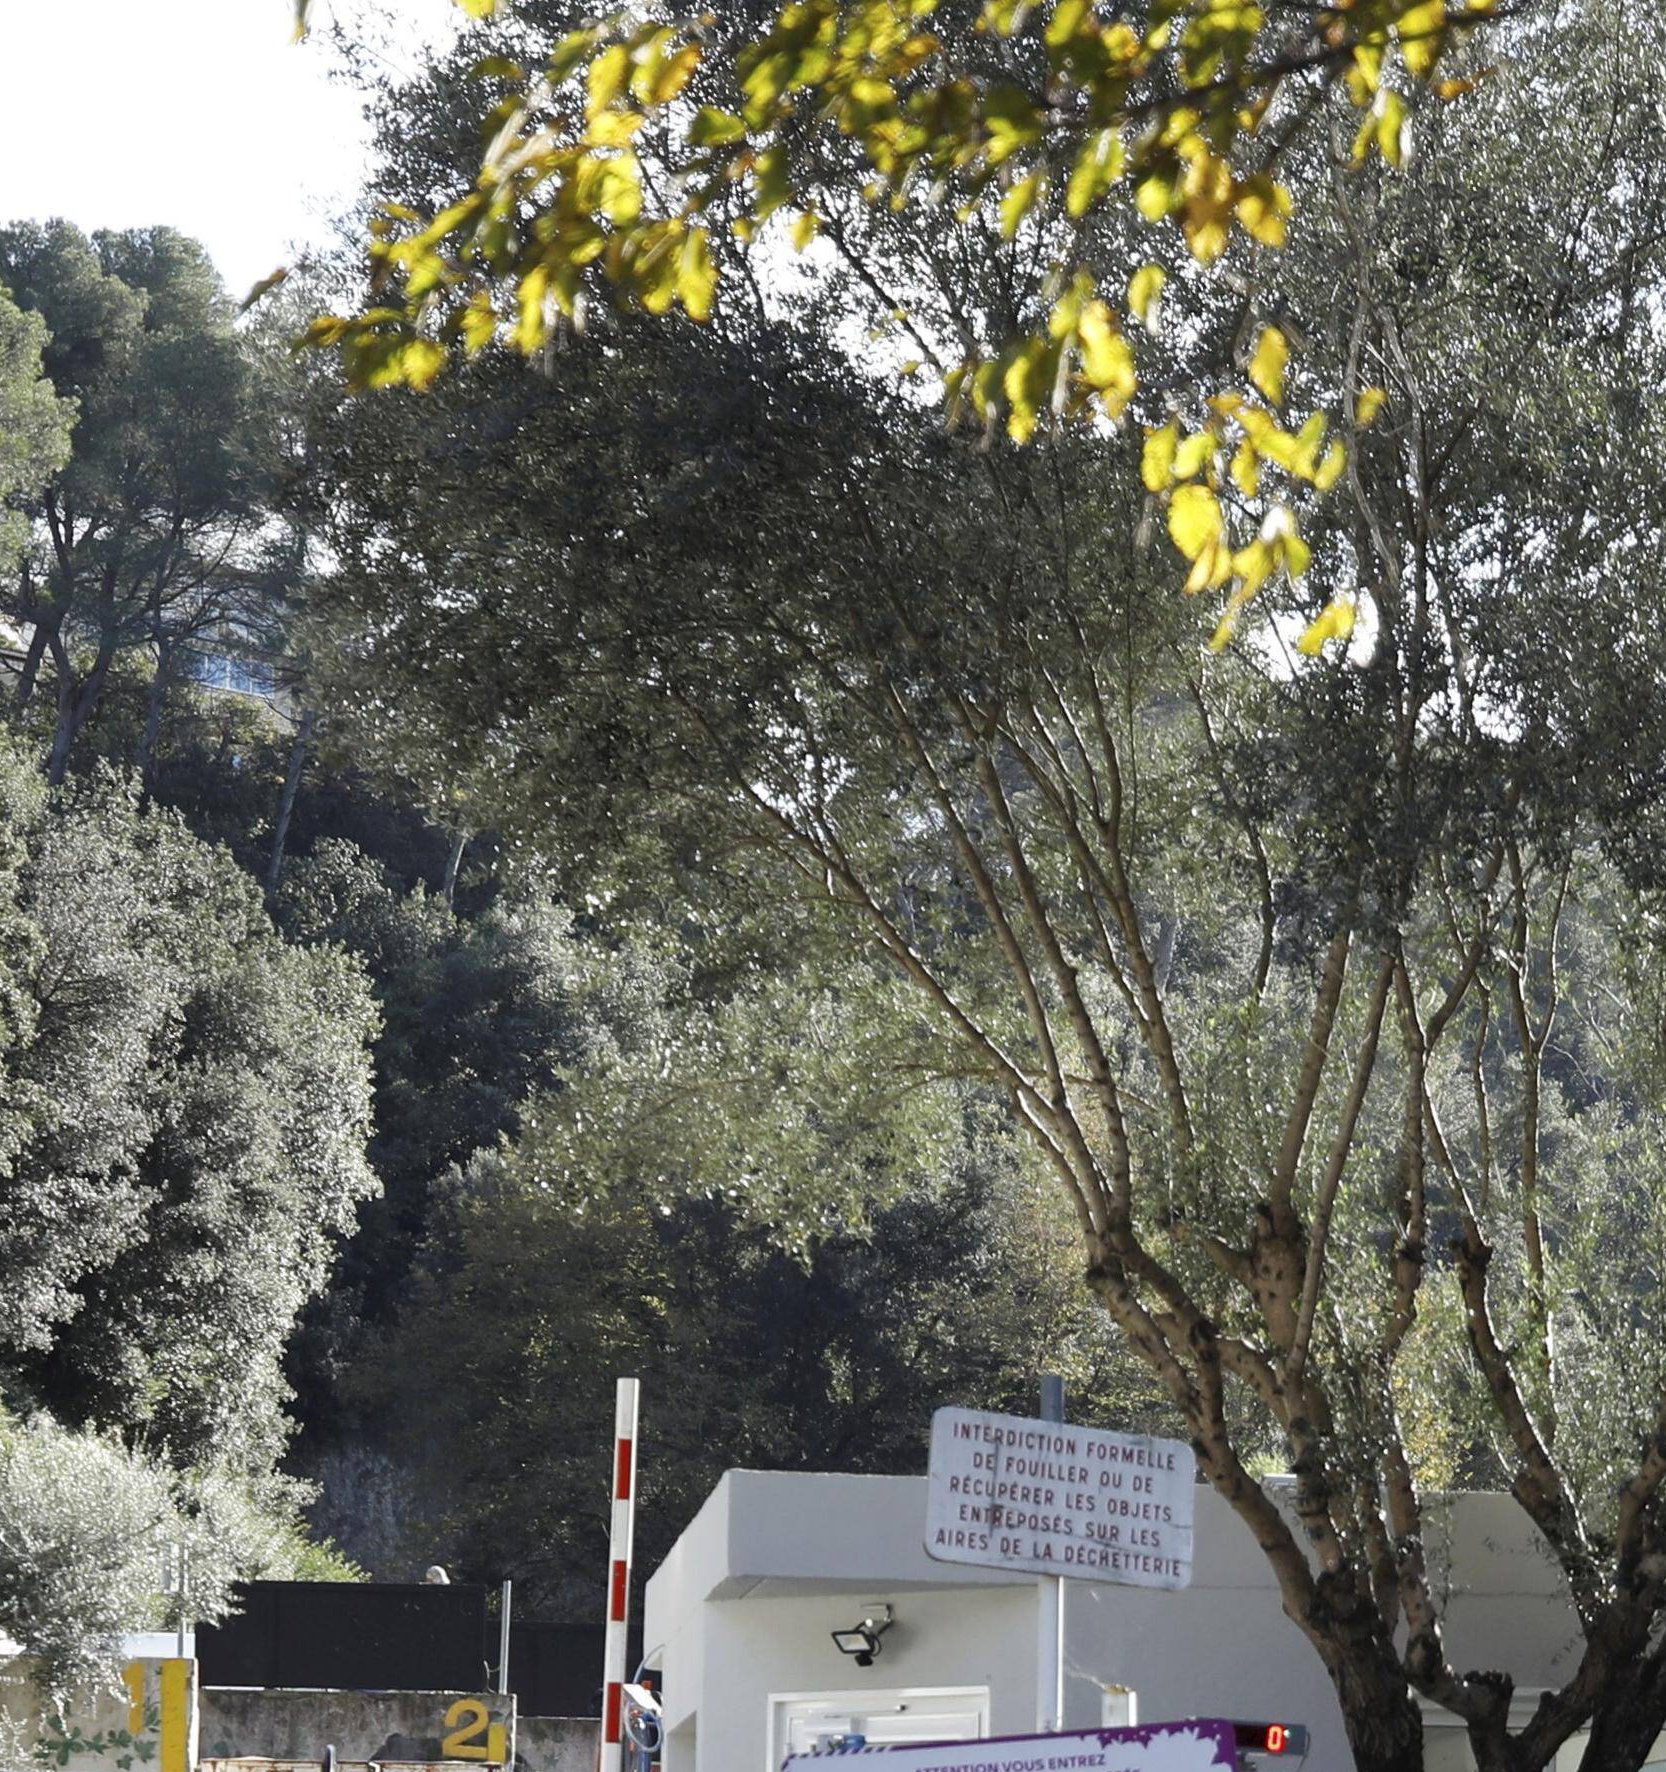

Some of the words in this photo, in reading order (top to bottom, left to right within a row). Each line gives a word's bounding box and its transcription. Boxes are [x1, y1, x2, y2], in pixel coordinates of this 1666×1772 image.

[953, 1421, 1076, 1457] INTERDICTION
[1087, 1441, 1175, 1471] FORMELLE
[973, 1452, 994, 1471] DE
[1006, 1456, 1089, 1485] FOUILLER
[1100, 1471, 1122, 1489] OU
[1133, 1476, 1153, 1494] DE
[950, 1474, 1054, 1505] RÉCUPÉRER
[1065, 1493, 1096, 1511] LES
[1107, 1498, 1172, 1522] OBJETS
[959, 1504, 1073, 1535] ENTREPOSÉS
[1085, 1522, 1120, 1542] SUR
[1130, 1528, 1161, 1548] LES
[935, 1528, 989, 1550] AIRES
[1000, 1537, 1022, 1556] DE
[1033, 1542, 1053, 1560] LA
[1064, 1544, 1181, 1577] DÉCHETTERIE
[442, 1698, 488, 1759] 2
[1267, 1725, 1283, 1750] 0
[1048, 1754, 1106, 1771] ENTREZ
